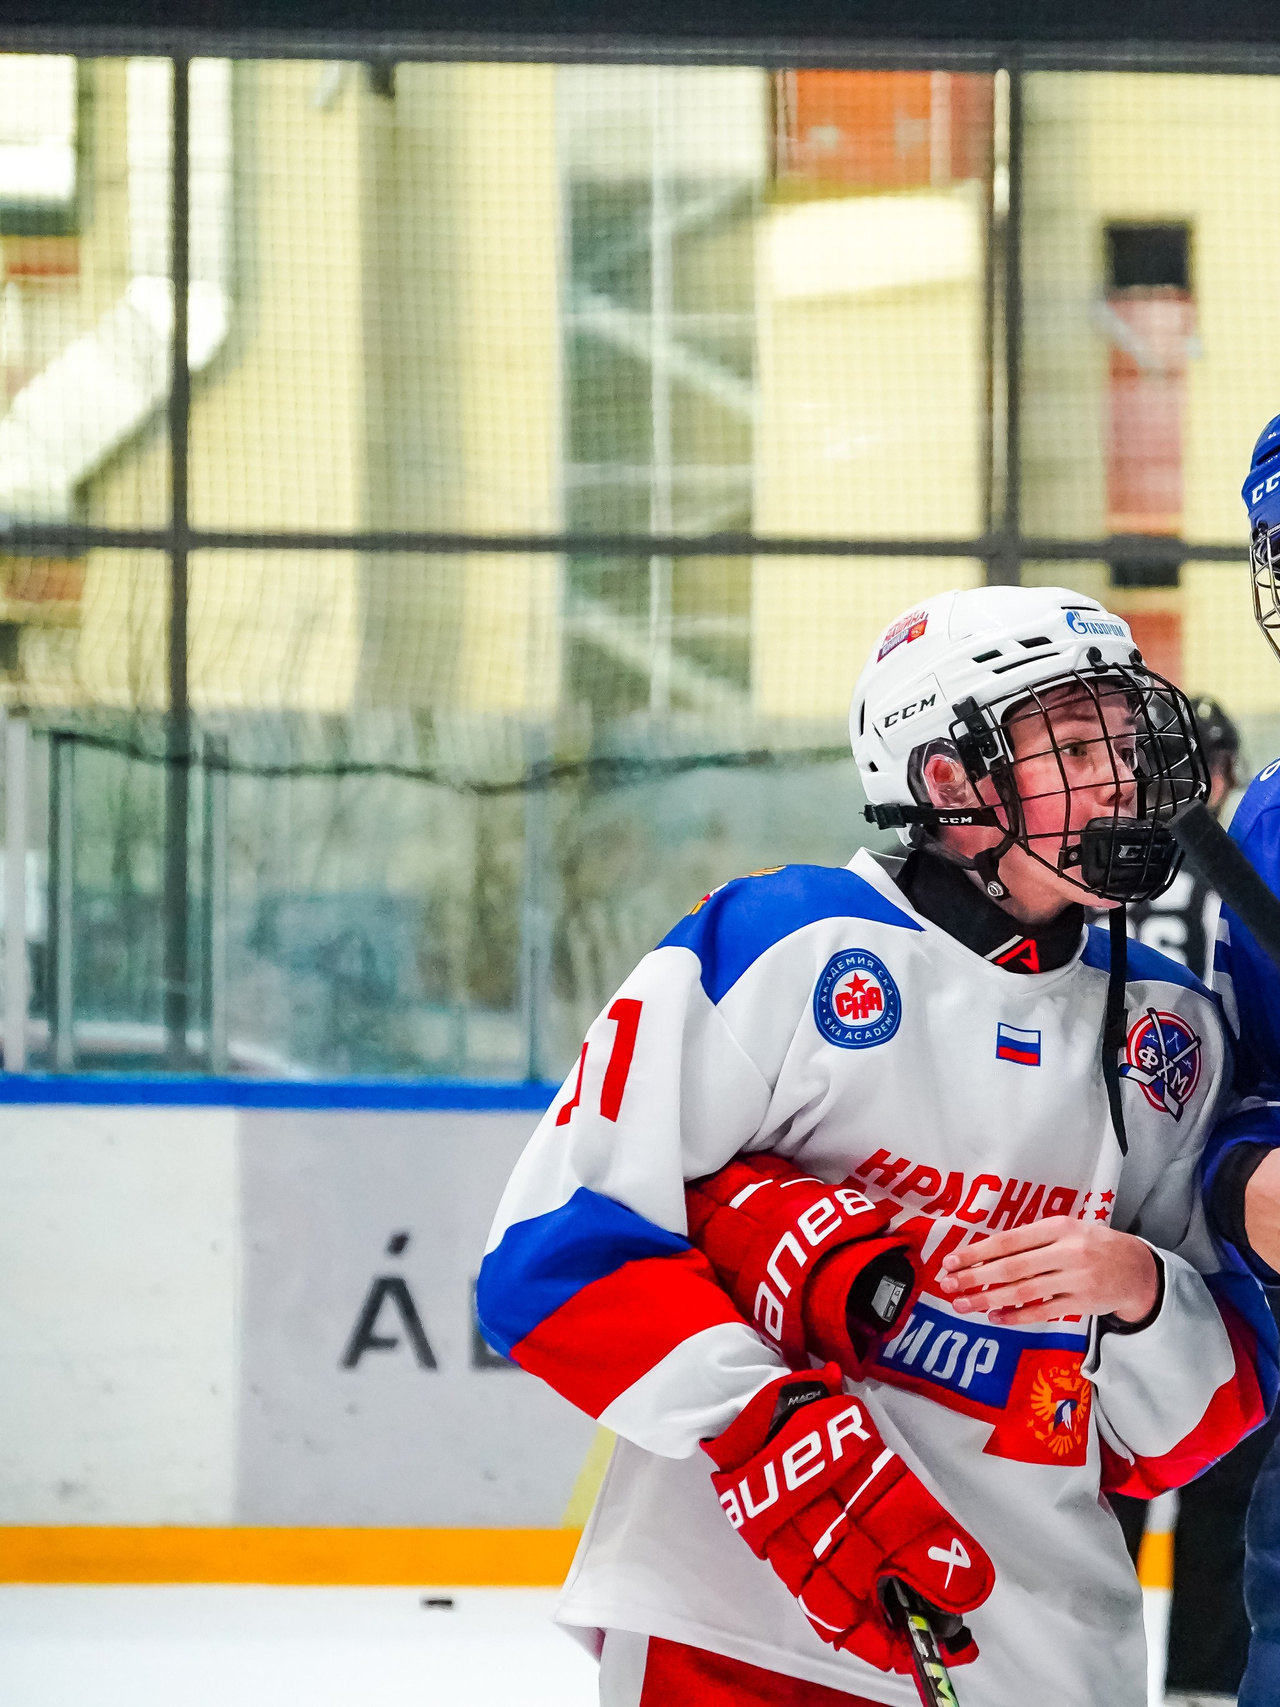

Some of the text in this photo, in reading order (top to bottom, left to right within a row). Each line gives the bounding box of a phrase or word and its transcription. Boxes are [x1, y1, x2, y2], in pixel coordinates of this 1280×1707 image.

[884, 693, 938, 730] CCM
[938, 816, 973, 826] CCM
[821, 956, 875, 1003] АКАДЕМИЯ
[824, 1009, 895, 1040] SKA ACADEMY
